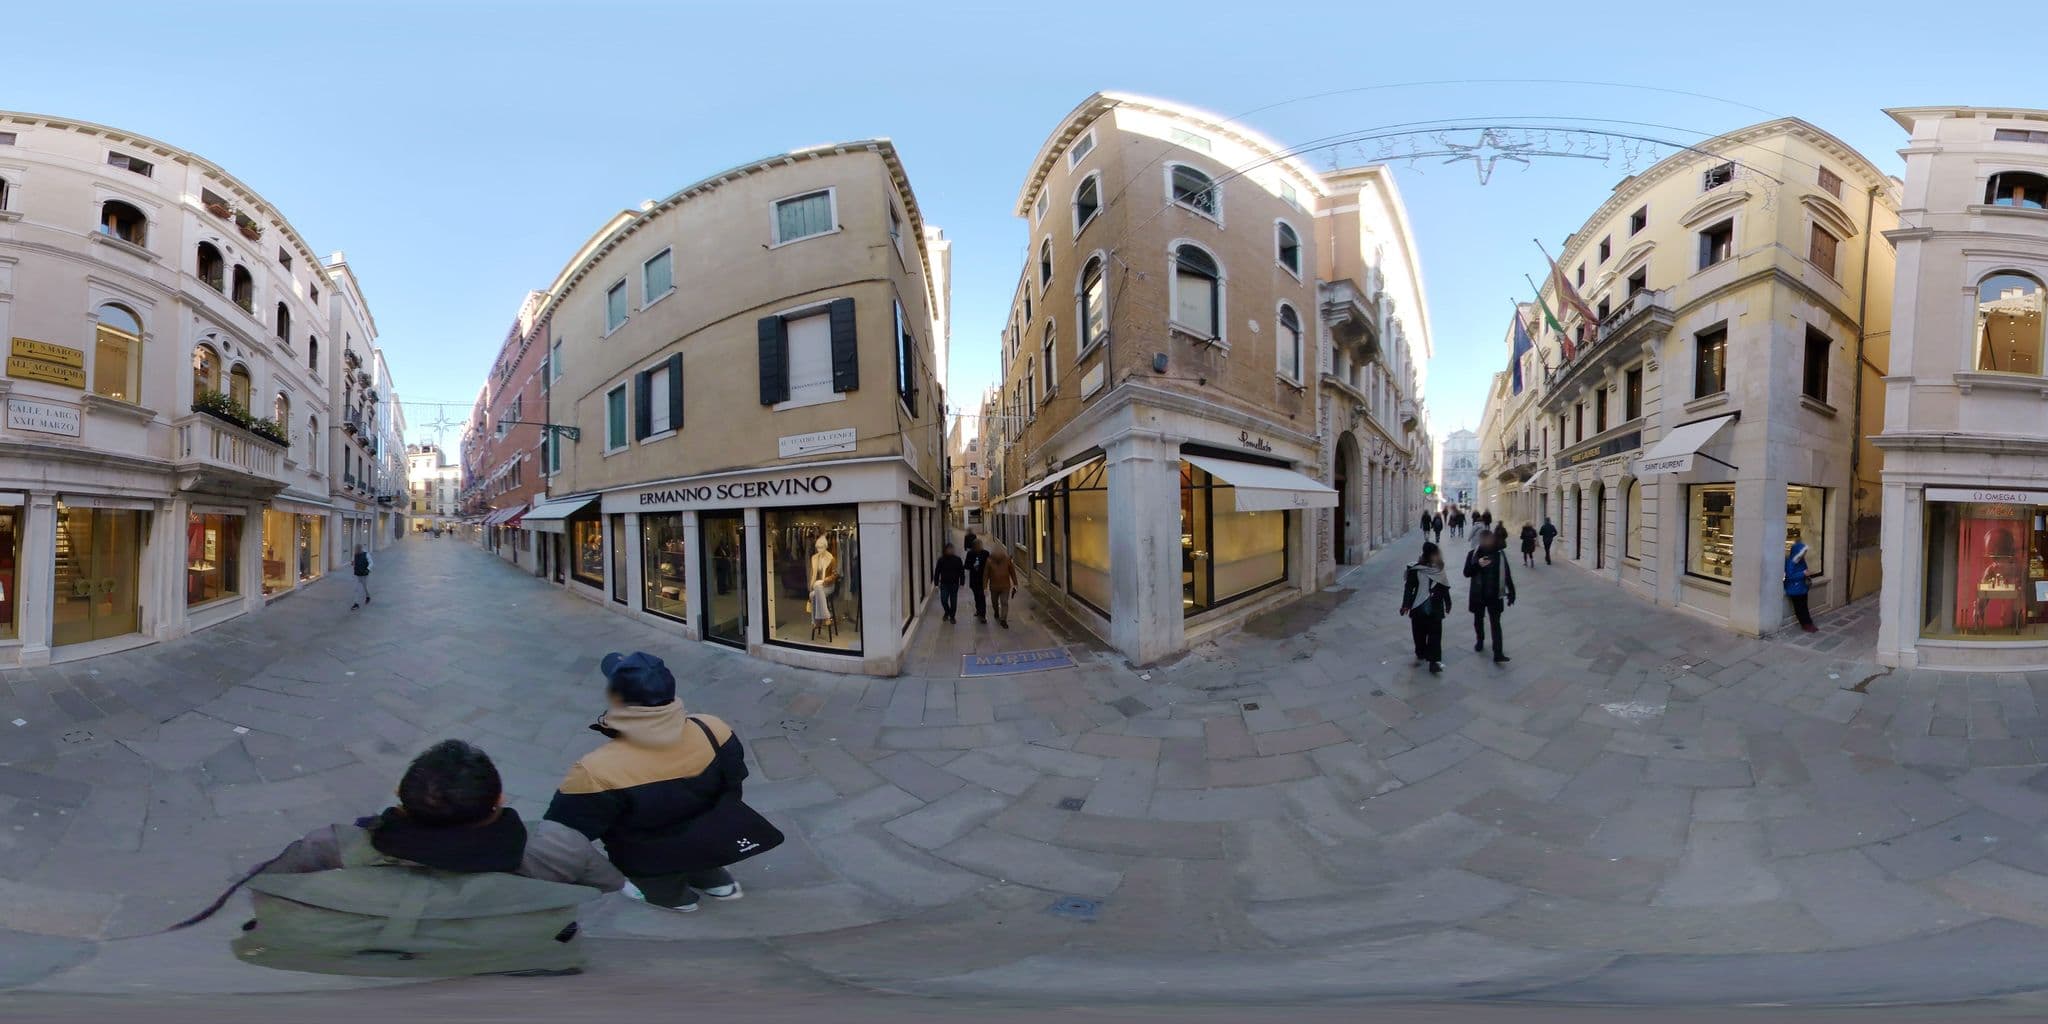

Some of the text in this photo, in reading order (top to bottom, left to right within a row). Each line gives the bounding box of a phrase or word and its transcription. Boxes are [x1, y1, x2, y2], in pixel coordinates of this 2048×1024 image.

[16, 340, 35, 350] PER
[33, 364, 84, 379] ACCADEMIA
[9, 403, 79, 422] CALLE LARGA
[14, 416, 74, 432] XXII MARZO
[1238, 430, 1272, 453] Pomellato
[1644, 459, 1684, 471] SAINT LAURENT
[639, 475, 833, 505] ERMANNO SCERVINO
[1985, 493, 2015, 501] OMEGA
[975, 650, 1057, 665] MARTINI
